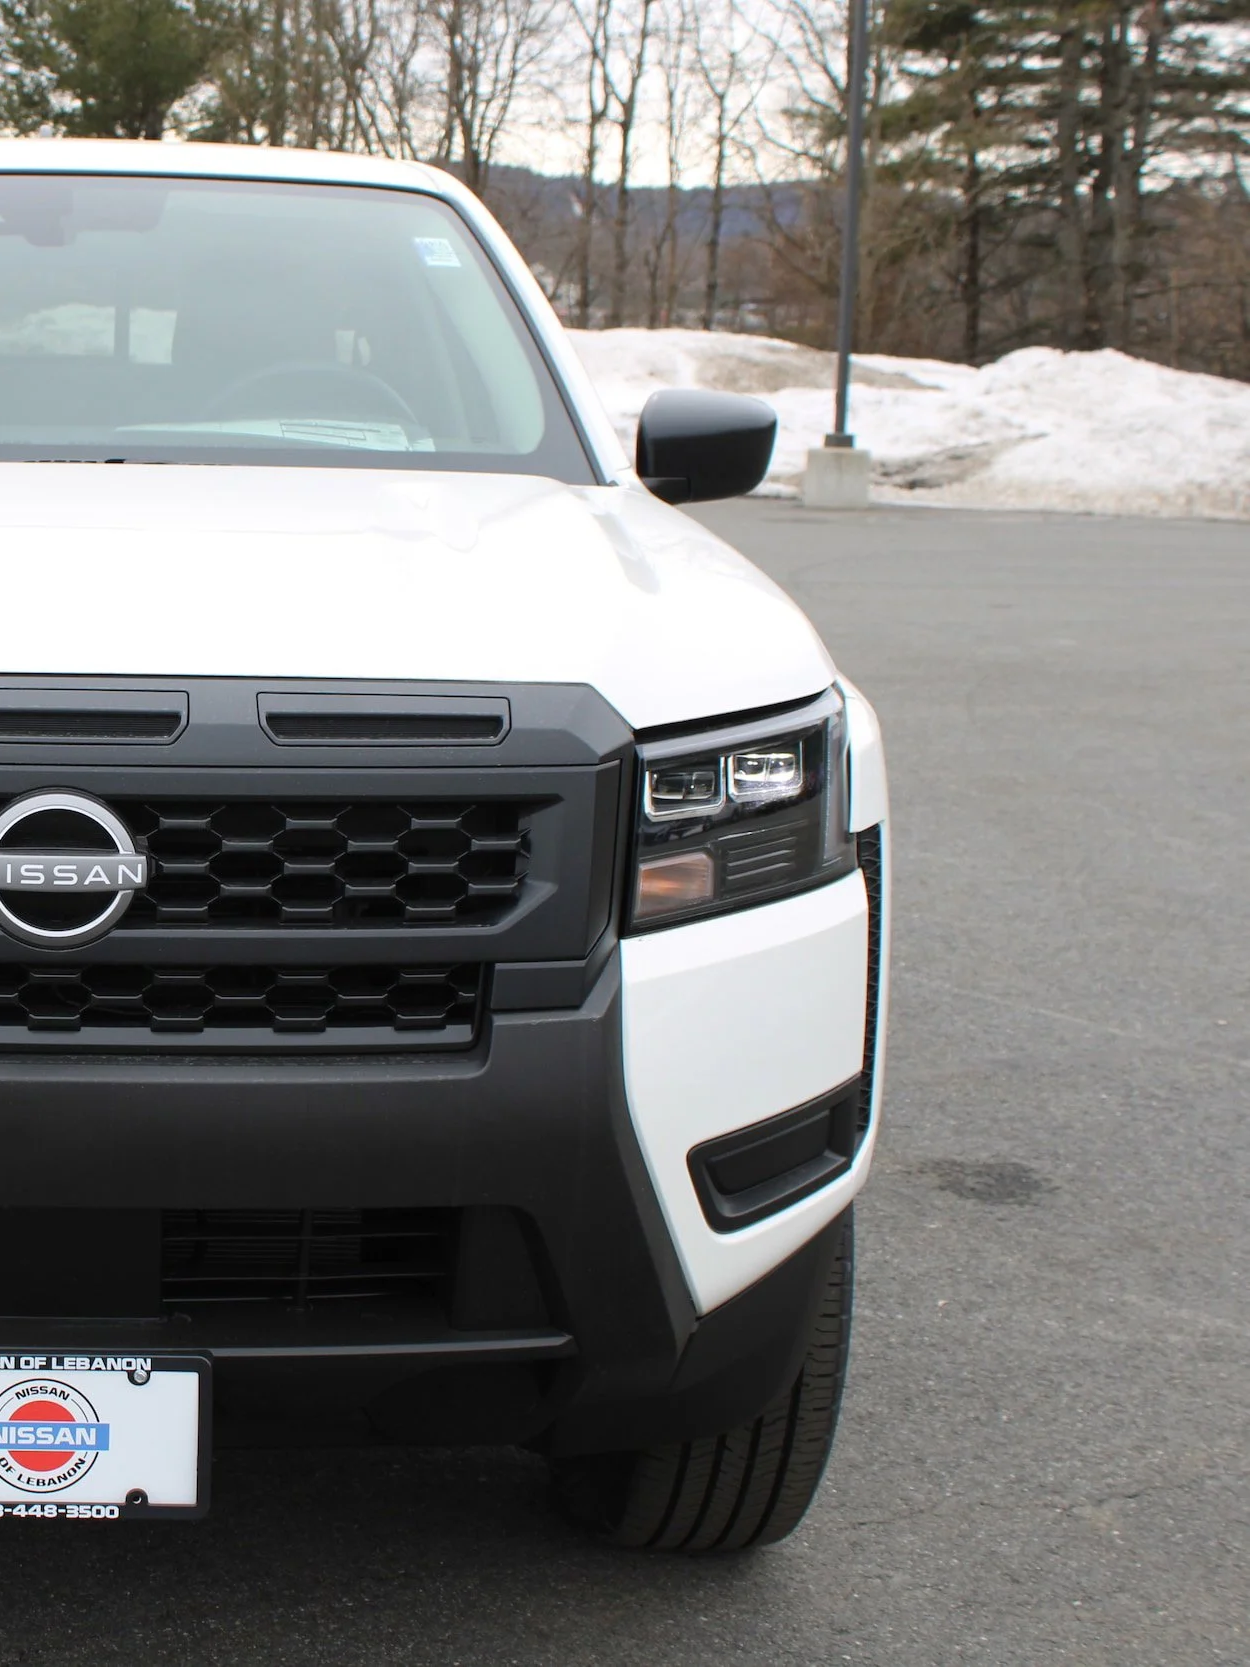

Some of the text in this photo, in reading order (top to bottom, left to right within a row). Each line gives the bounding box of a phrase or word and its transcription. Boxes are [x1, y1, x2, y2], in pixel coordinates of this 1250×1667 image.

[20, 1356, 47, 1370] OF
[52, 1356, 152, 1371] LEBANON
[14, 1385, 71, 1401] NISSAN
[17, 1457, 87, 1487] LEBANON
